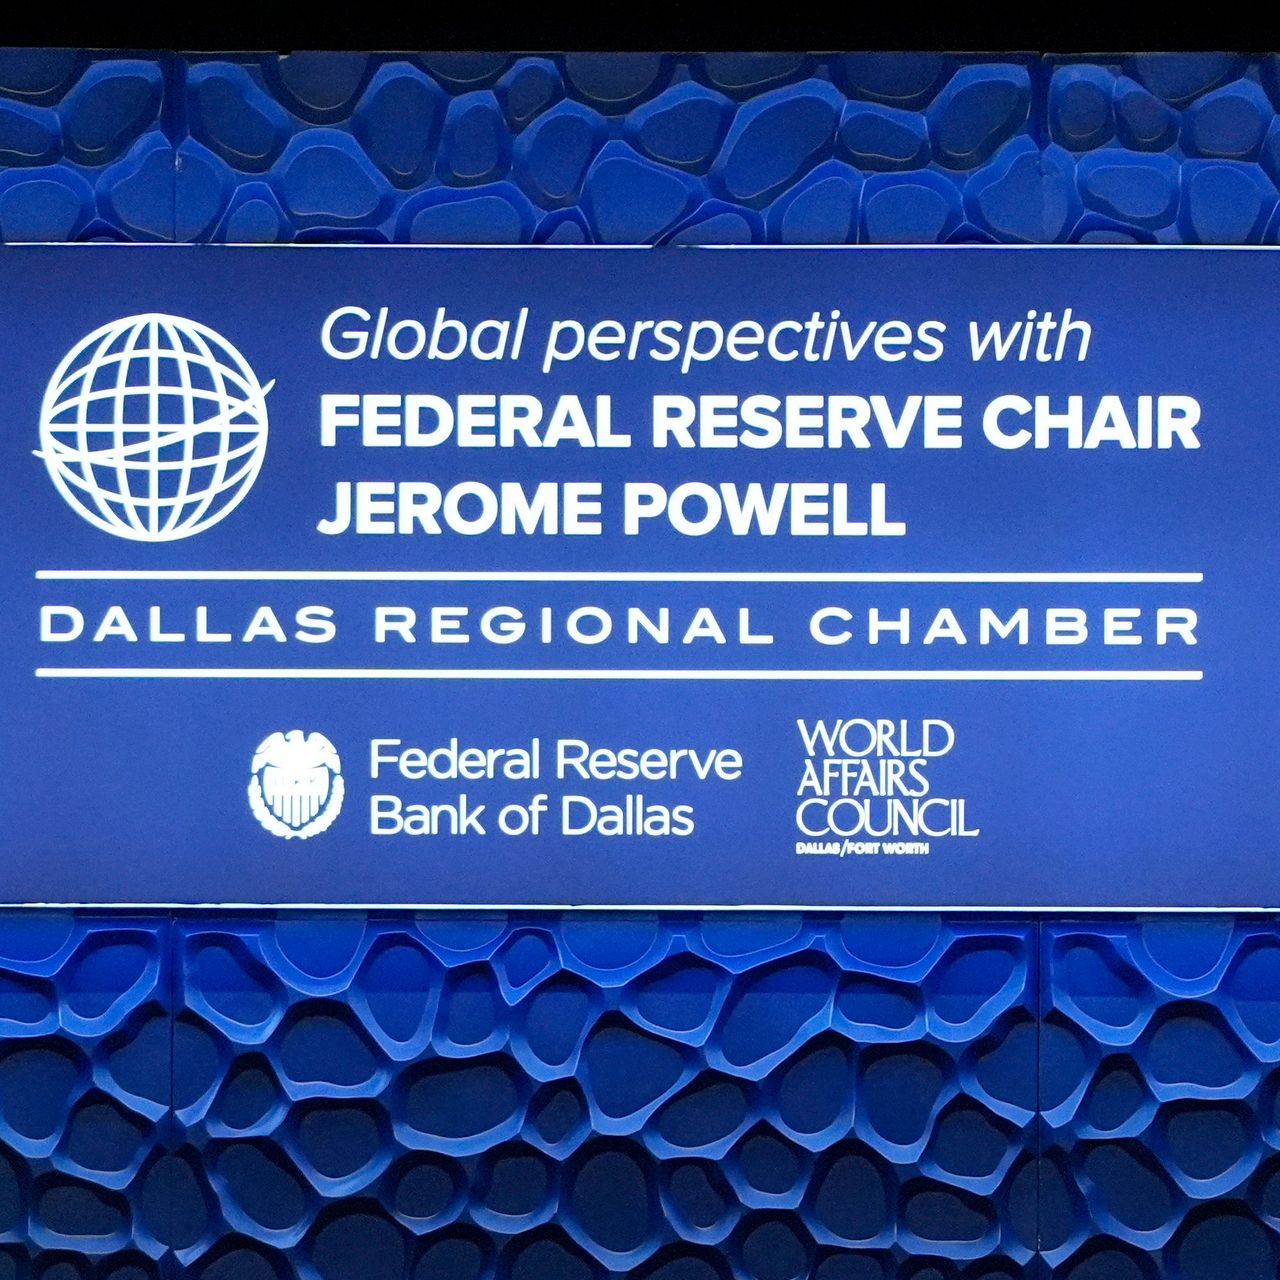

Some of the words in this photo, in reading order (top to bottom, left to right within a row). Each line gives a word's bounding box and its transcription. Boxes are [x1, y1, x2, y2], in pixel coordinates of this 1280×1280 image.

[321, 305, 529, 361] Global
[542, 305, 947, 374] perspectives
[969, 307, 1092, 362] with
[320, 393, 632, 448] FEDERAL
[652, 394, 963, 449] RESERVE
[982, 394, 1201, 450] CHAIR
[316, 481, 603, 536] JEROME
[624, 481, 907, 537] POWELL
[40, 605, 337, 644] DALLAS
[374, 605, 774, 645] REGIONAL
[809, 606, 1198, 646] CHAMBER
[796, 718, 955, 757] WORLD
[370, 737, 540, 780] Federal
[556, 739, 743, 781] Reserve
[796, 758, 930, 797] AFFAIRS
[370, 793, 486, 836] Bank
[498, 793, 548, 836] of
[562, 794, 695, 837] Dallas
[795, 798, 980, 837] COUNCIL
[881, 842, 930, 855] WORTH
